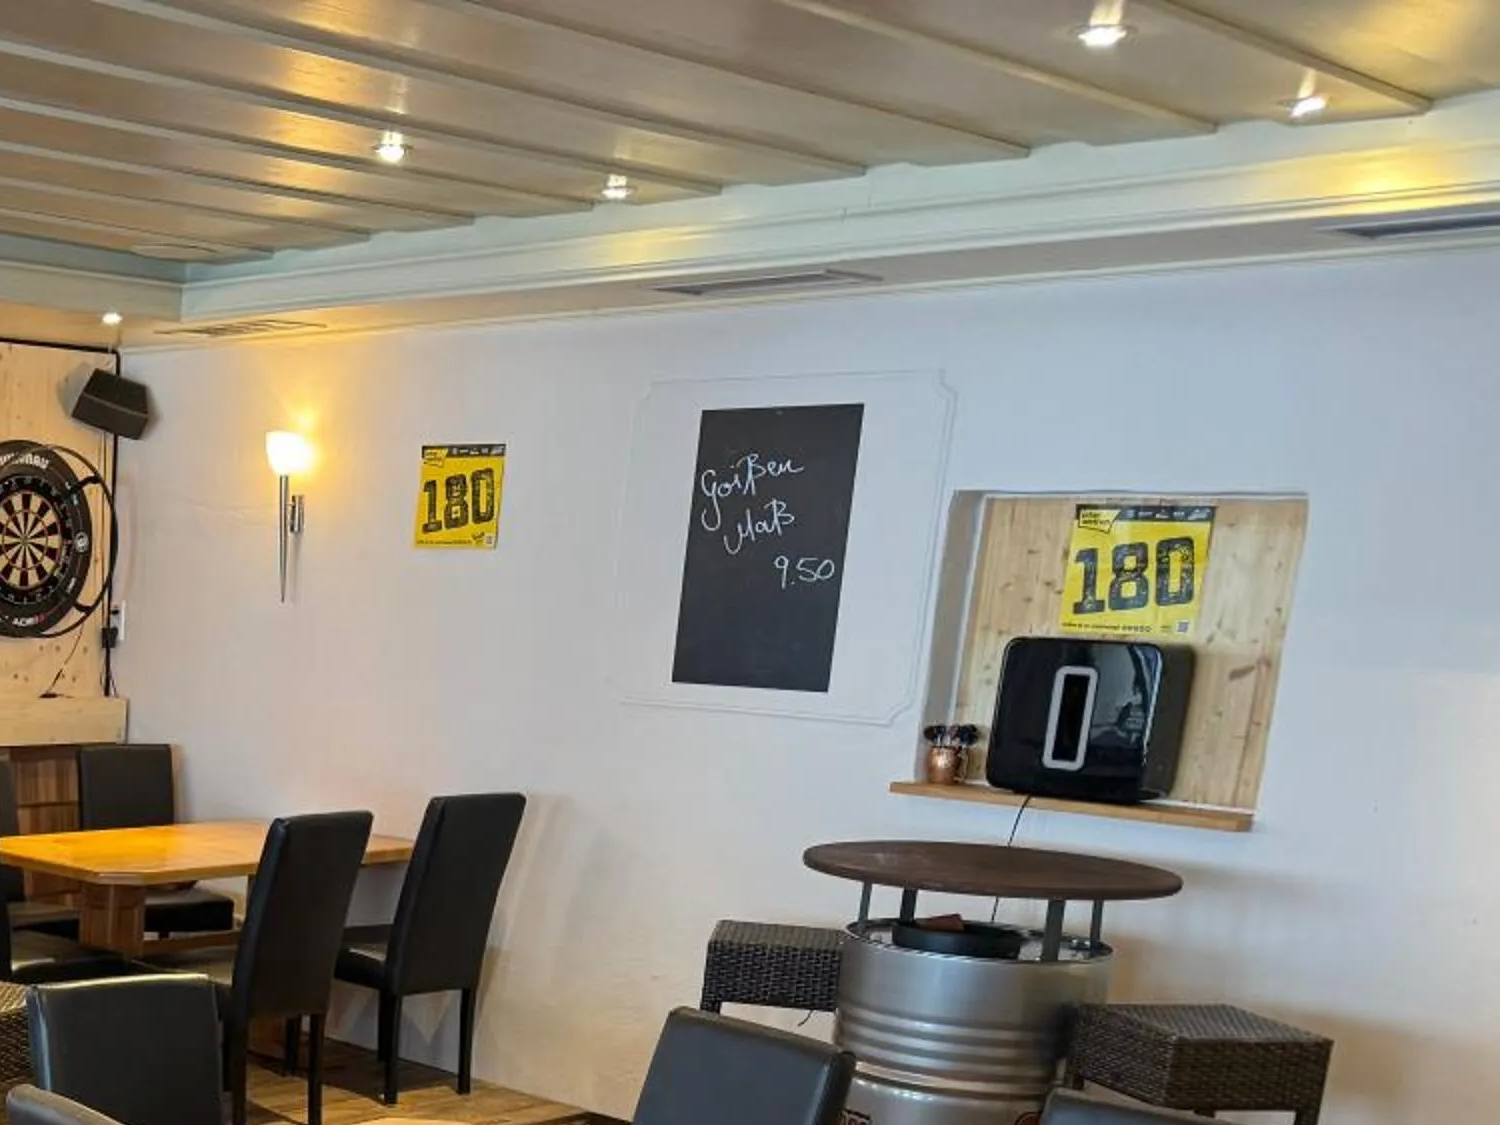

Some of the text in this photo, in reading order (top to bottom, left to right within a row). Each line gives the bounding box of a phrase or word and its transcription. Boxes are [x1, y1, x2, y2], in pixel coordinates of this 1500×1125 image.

[422, 467, 494, 534] 180
[773, 556, 836, 589] 9.50
[1073, 536, 1194, 614] 180
